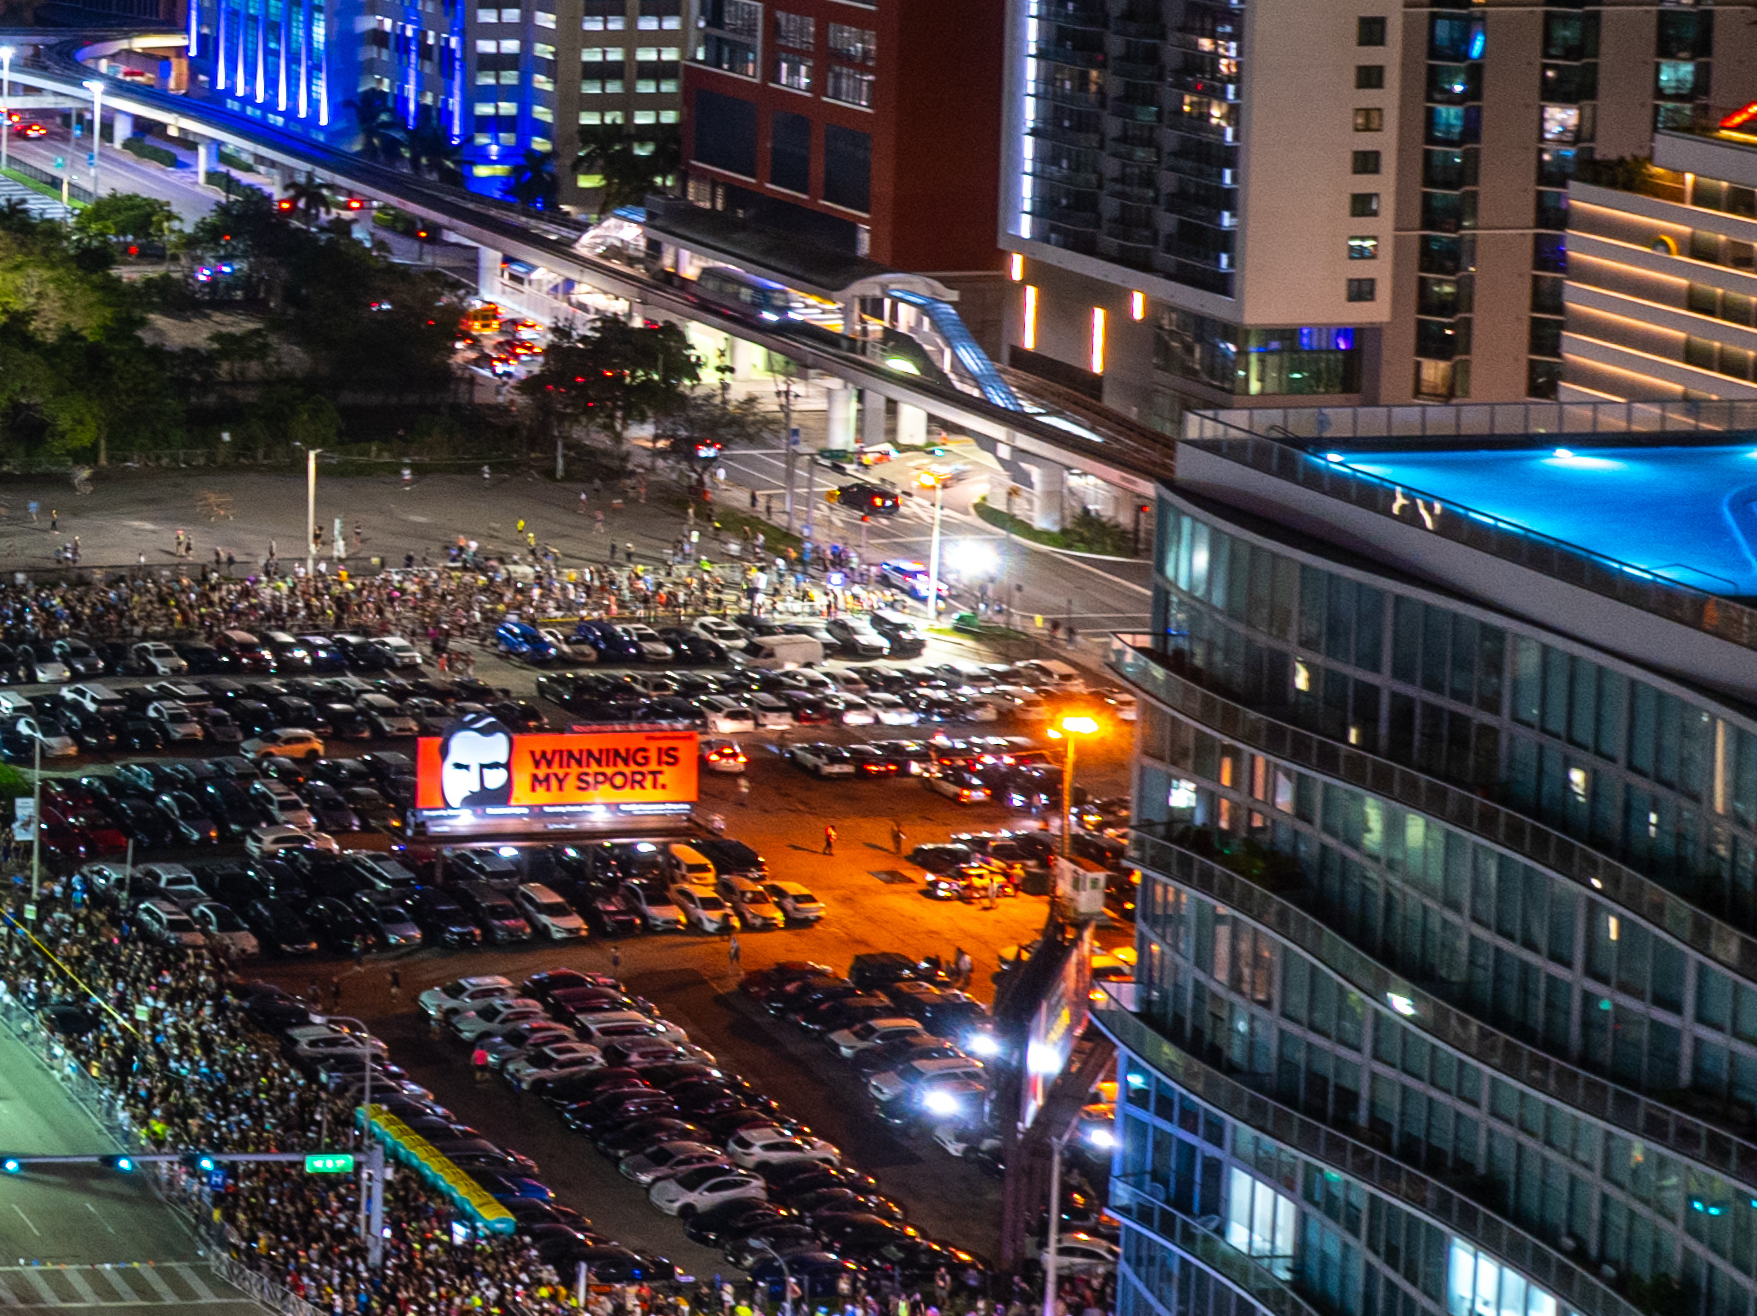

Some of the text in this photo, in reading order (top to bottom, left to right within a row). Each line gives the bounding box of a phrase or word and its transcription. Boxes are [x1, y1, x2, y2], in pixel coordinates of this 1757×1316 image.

[530, 747, 679, 769] WINNING IS
[531, 770, 667, 792] MY SPORT.
